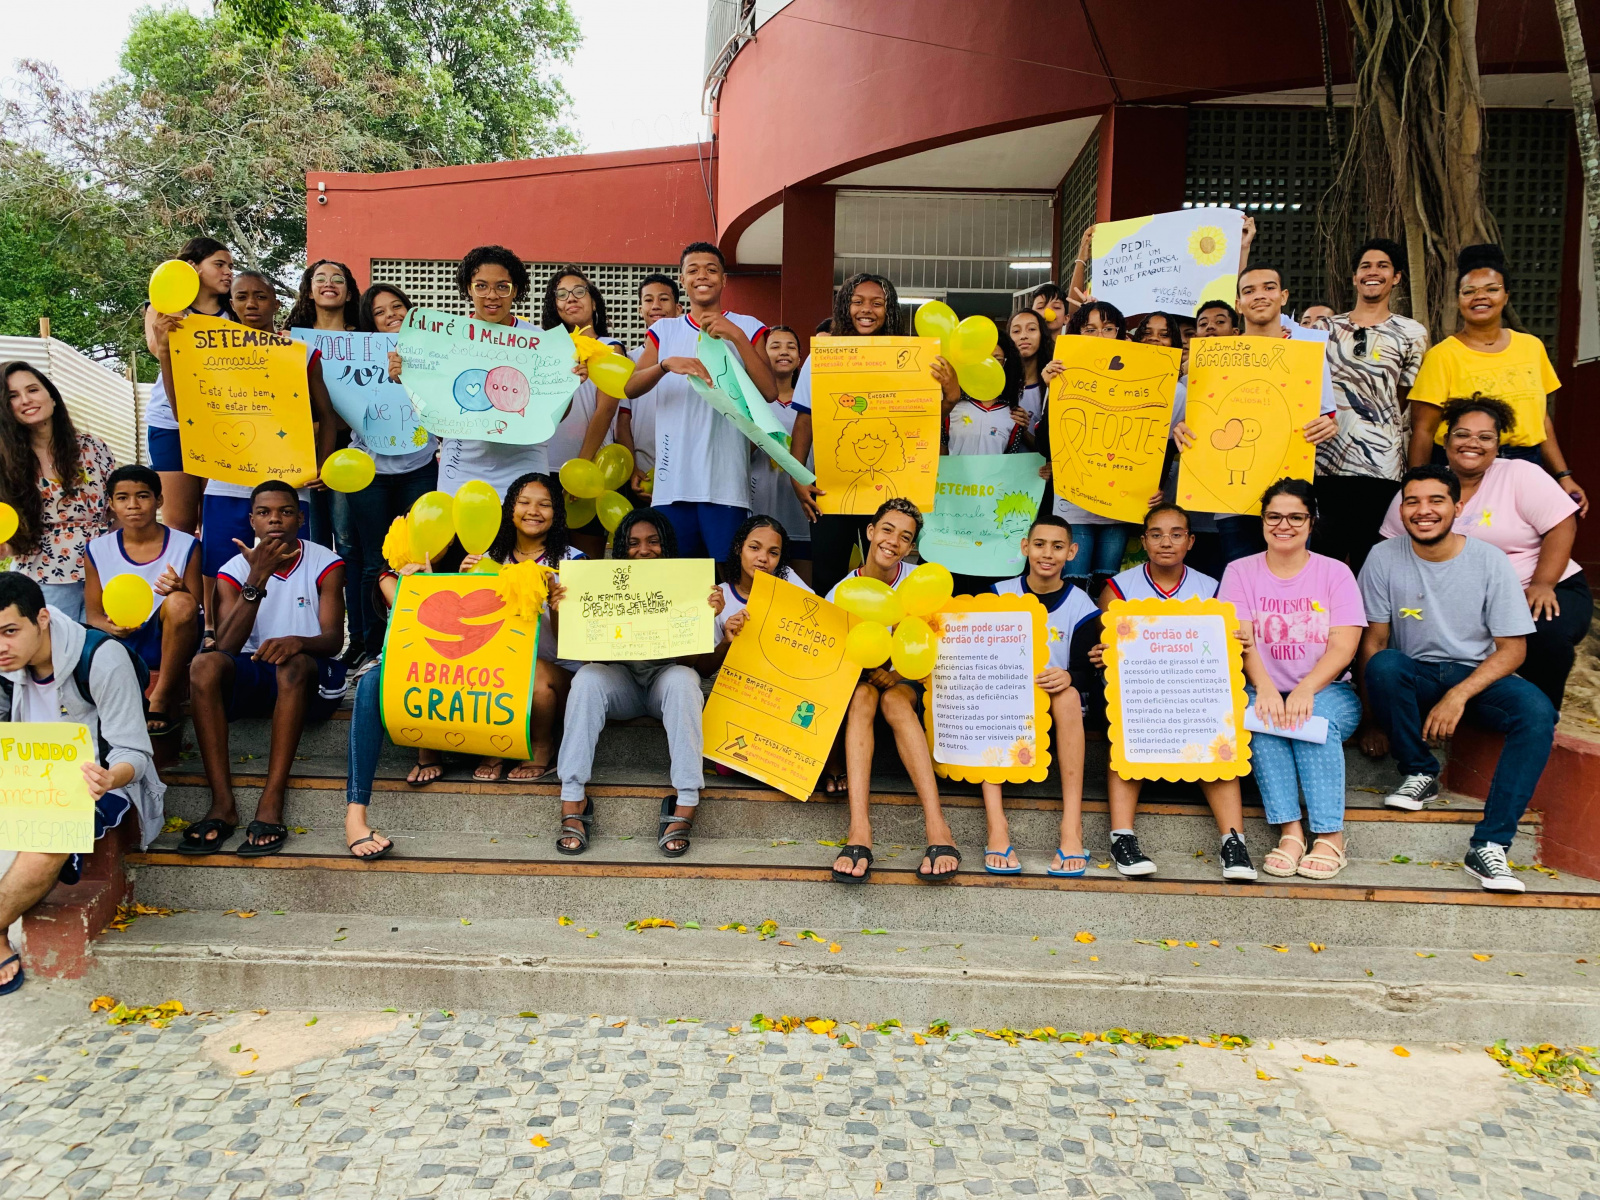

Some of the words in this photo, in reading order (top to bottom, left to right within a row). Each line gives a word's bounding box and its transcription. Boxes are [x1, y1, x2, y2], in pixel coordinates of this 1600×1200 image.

[1120, 239, 1152, 253] PEDIR
[1103, 254, 1133, 267] AJUDA
[1148, 248, 1161, 256] UM
[1102, 265, 1127, 276] SINAL
[1134, 261, 1144, 269] DE
[1101, 275, 1119, 287] NÃO
[1123, 274, 1135, 283] DE
[814, 347, 859, 355] CONSCIENTIZE
[1195, 353, 1269, 368] AMARELO
[199, 380, 223, 396] Está
[229, 385, 248, 398] tudo
[1109, 384, 1119, 396] é
[1124, 386, 1149, 398] mais
[1240, 386, 1261, 394] VOCÊ
[207, 401, 221, 410] não
[225, 402, 248, 412] estar
[904, 428, 921, 437] VOCÊ
[1089, 411, 1160, 455] FORTE
[657, 433, 670, 482] Vitória
[214, 457, 232, 469] não
[238, 461, 259, 474] está
[266, 463, 302, 475] sozinho
[1096, 462, 1107, 470] que
[1112, 463, 1134, 472] pensa
[612, 565, 632, 574] VOCÊ
[580, 591, 594, 602] NÃO
[598, 592, 624, 602] PERMITA
[624, 593, 641, 601] QUE
[1259, 596, 1315, 615] LOVESICK
[582, 610, 590, 618] O
[593, 609, 613, 618] RUMO
[616, 609, 626, 617] DA
[626, 608, 641, 616] SUA
[777, 617, 836, 648] SETEMBRO
[945, 623, 969, 633] Quem
[971, 623, 993, 635] pode
[995, 624, 1015, 632] usar
[1017, 624, 1023, 632] o
[1142, 629, 1182, 640] Cordão
[1185, 628, 1199, 640] de
[774, 633, 819, 657] amarelo
[941, 633, 972, 644] cordão
[974, 633, 985, 643] de
[987, 633, 1027, 646] girassol?
[1150, 642, 1193, 653] Girassol
[1270, 644, 1306, 661] GIRLS
[999, 663, 1025, 671] óbvias,
[1169, 658, 1199, 666] girassol
[406, 661, 505, 690] ABRAÇOS
[722, 667, 743, 681] Tenha
[745, 677, 774, 693] empatia
[988, 672, 1029, 680] mobilidade
[949, 682, 984, 692] utilização
[985, 682, 994, 690] de
[995, 682, 1026, 690] cadeiras
[1167, 677, 1227, 686] conscientização
[944, 693, 965, 701] rodas,
[976, 692, 1019, 701] deficiências
[1131, 688, 1153, 696] apoio
[1161, 688, 1191, 696] pessoas
[403, 686, 515, 726] GRÁTIS
[1127, 707, 1162, 715] Inspirado
[937, 712, 985, 721] caracterizadas
[986, 714, 999, 722] por
[1000, 713, 1034, 721] sintomas
[1183, 716, 1219, 725] girassóis,
[938, 722, 963, 731] internos
[975, 722, 1017, 731] emocionais
[1018, 724, 1032, 732] que
[1174, 727, 1217, 735] representa
[938, 732, 959, 740] podem
[960, 733, 973, 741] não
[1015, 734, 1033, 742] para
[0, 737, 78, 762] FUNDO
[946, 742, 969, 750] outros.
[1130, 747, 1183, 755] compreensão.
[794, 752, 817, 767] JULGUE
[14, 765, 32, 777] AR
[16, 819, 93, 849] RESPIRAR
